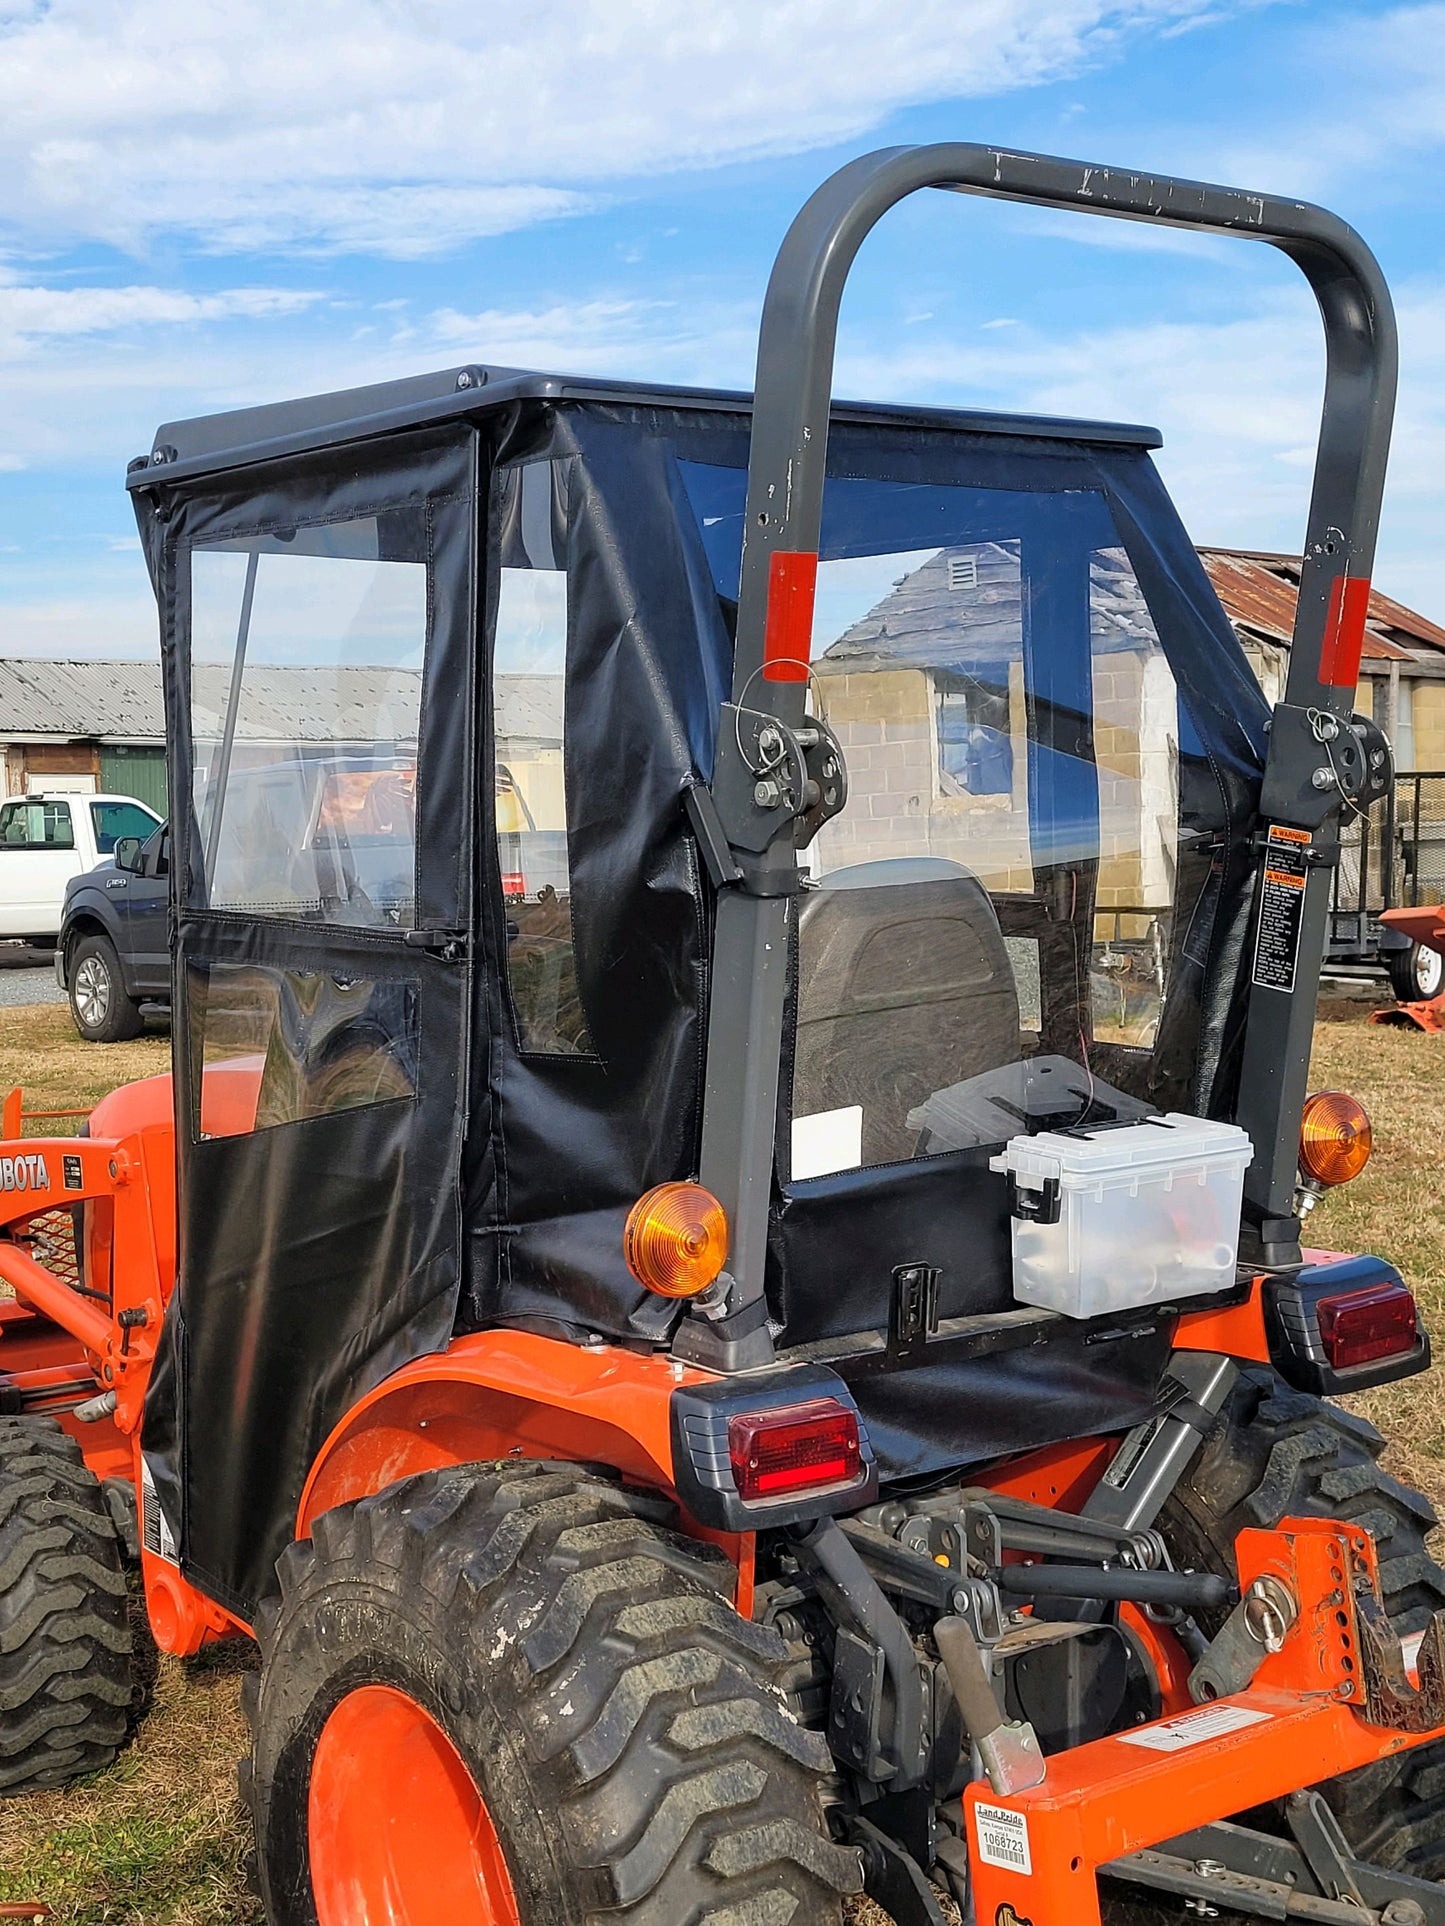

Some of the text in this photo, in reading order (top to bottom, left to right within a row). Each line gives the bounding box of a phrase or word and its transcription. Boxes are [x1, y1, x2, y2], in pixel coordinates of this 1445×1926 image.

[1279, 830, 1308, 842] WARNING
[1274, 874, 1303, 886] WARNING
[977, 1805, 1023, 1826] Land Pride
[984, 1832, 1024, 1853] 1068723
